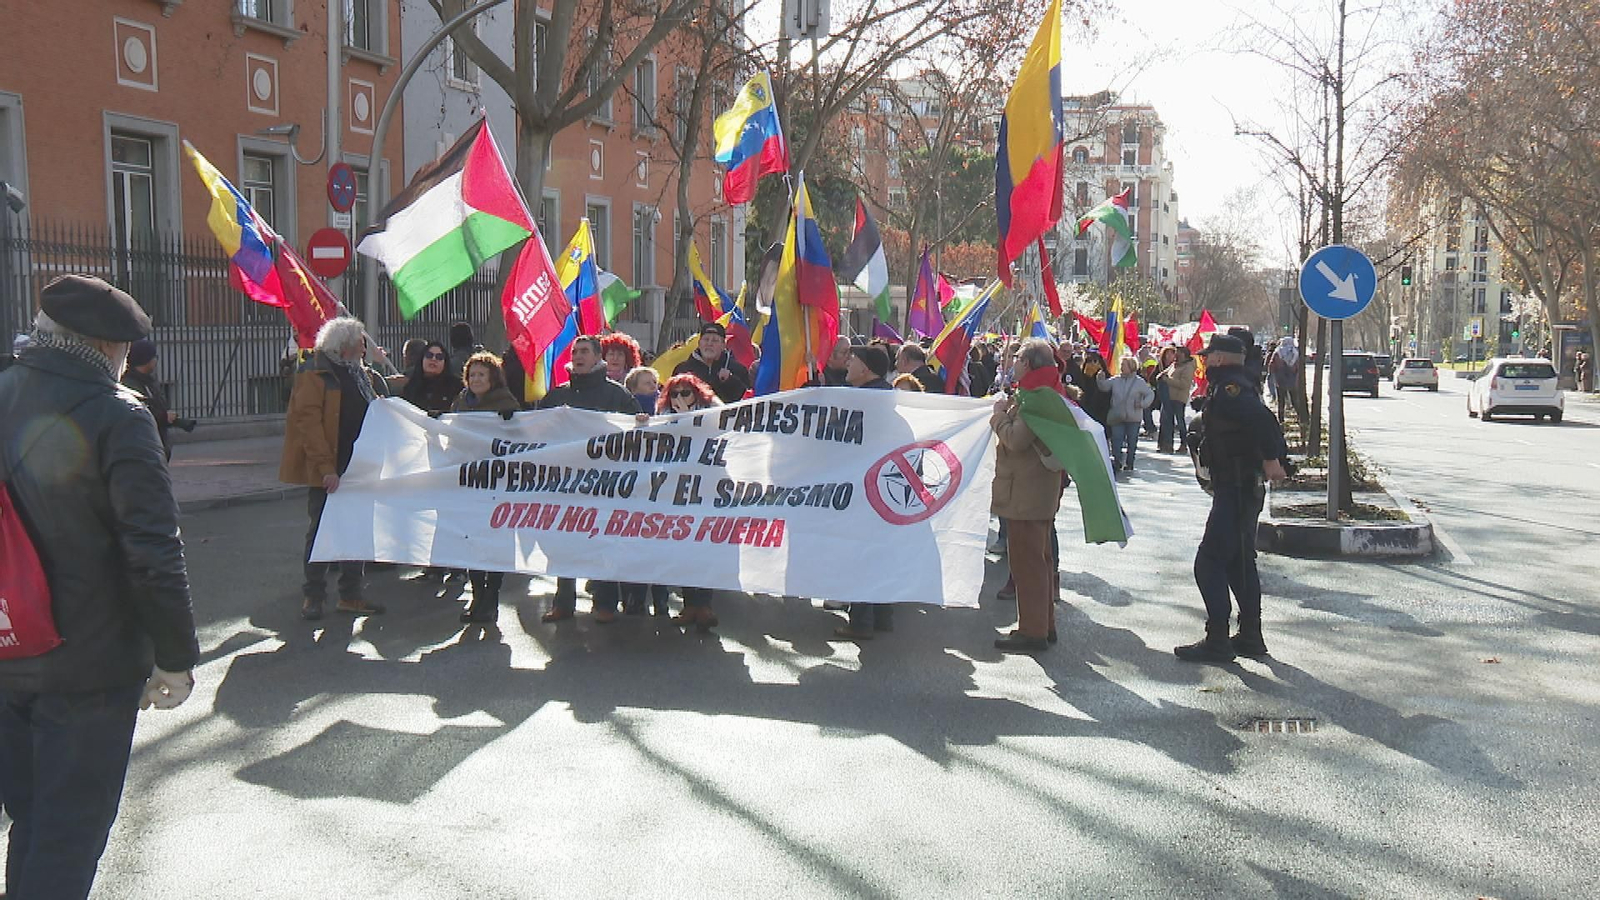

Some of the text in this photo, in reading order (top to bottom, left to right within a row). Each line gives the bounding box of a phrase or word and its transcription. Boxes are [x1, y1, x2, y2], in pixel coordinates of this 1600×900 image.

[587, 429, 727, 467] CONTRA EL
[459, 459, 854, 510] IMPERIALISMO Y EL SIONISMO
[490, 501, 785, 547] OTAN NO, BASES FUERA
